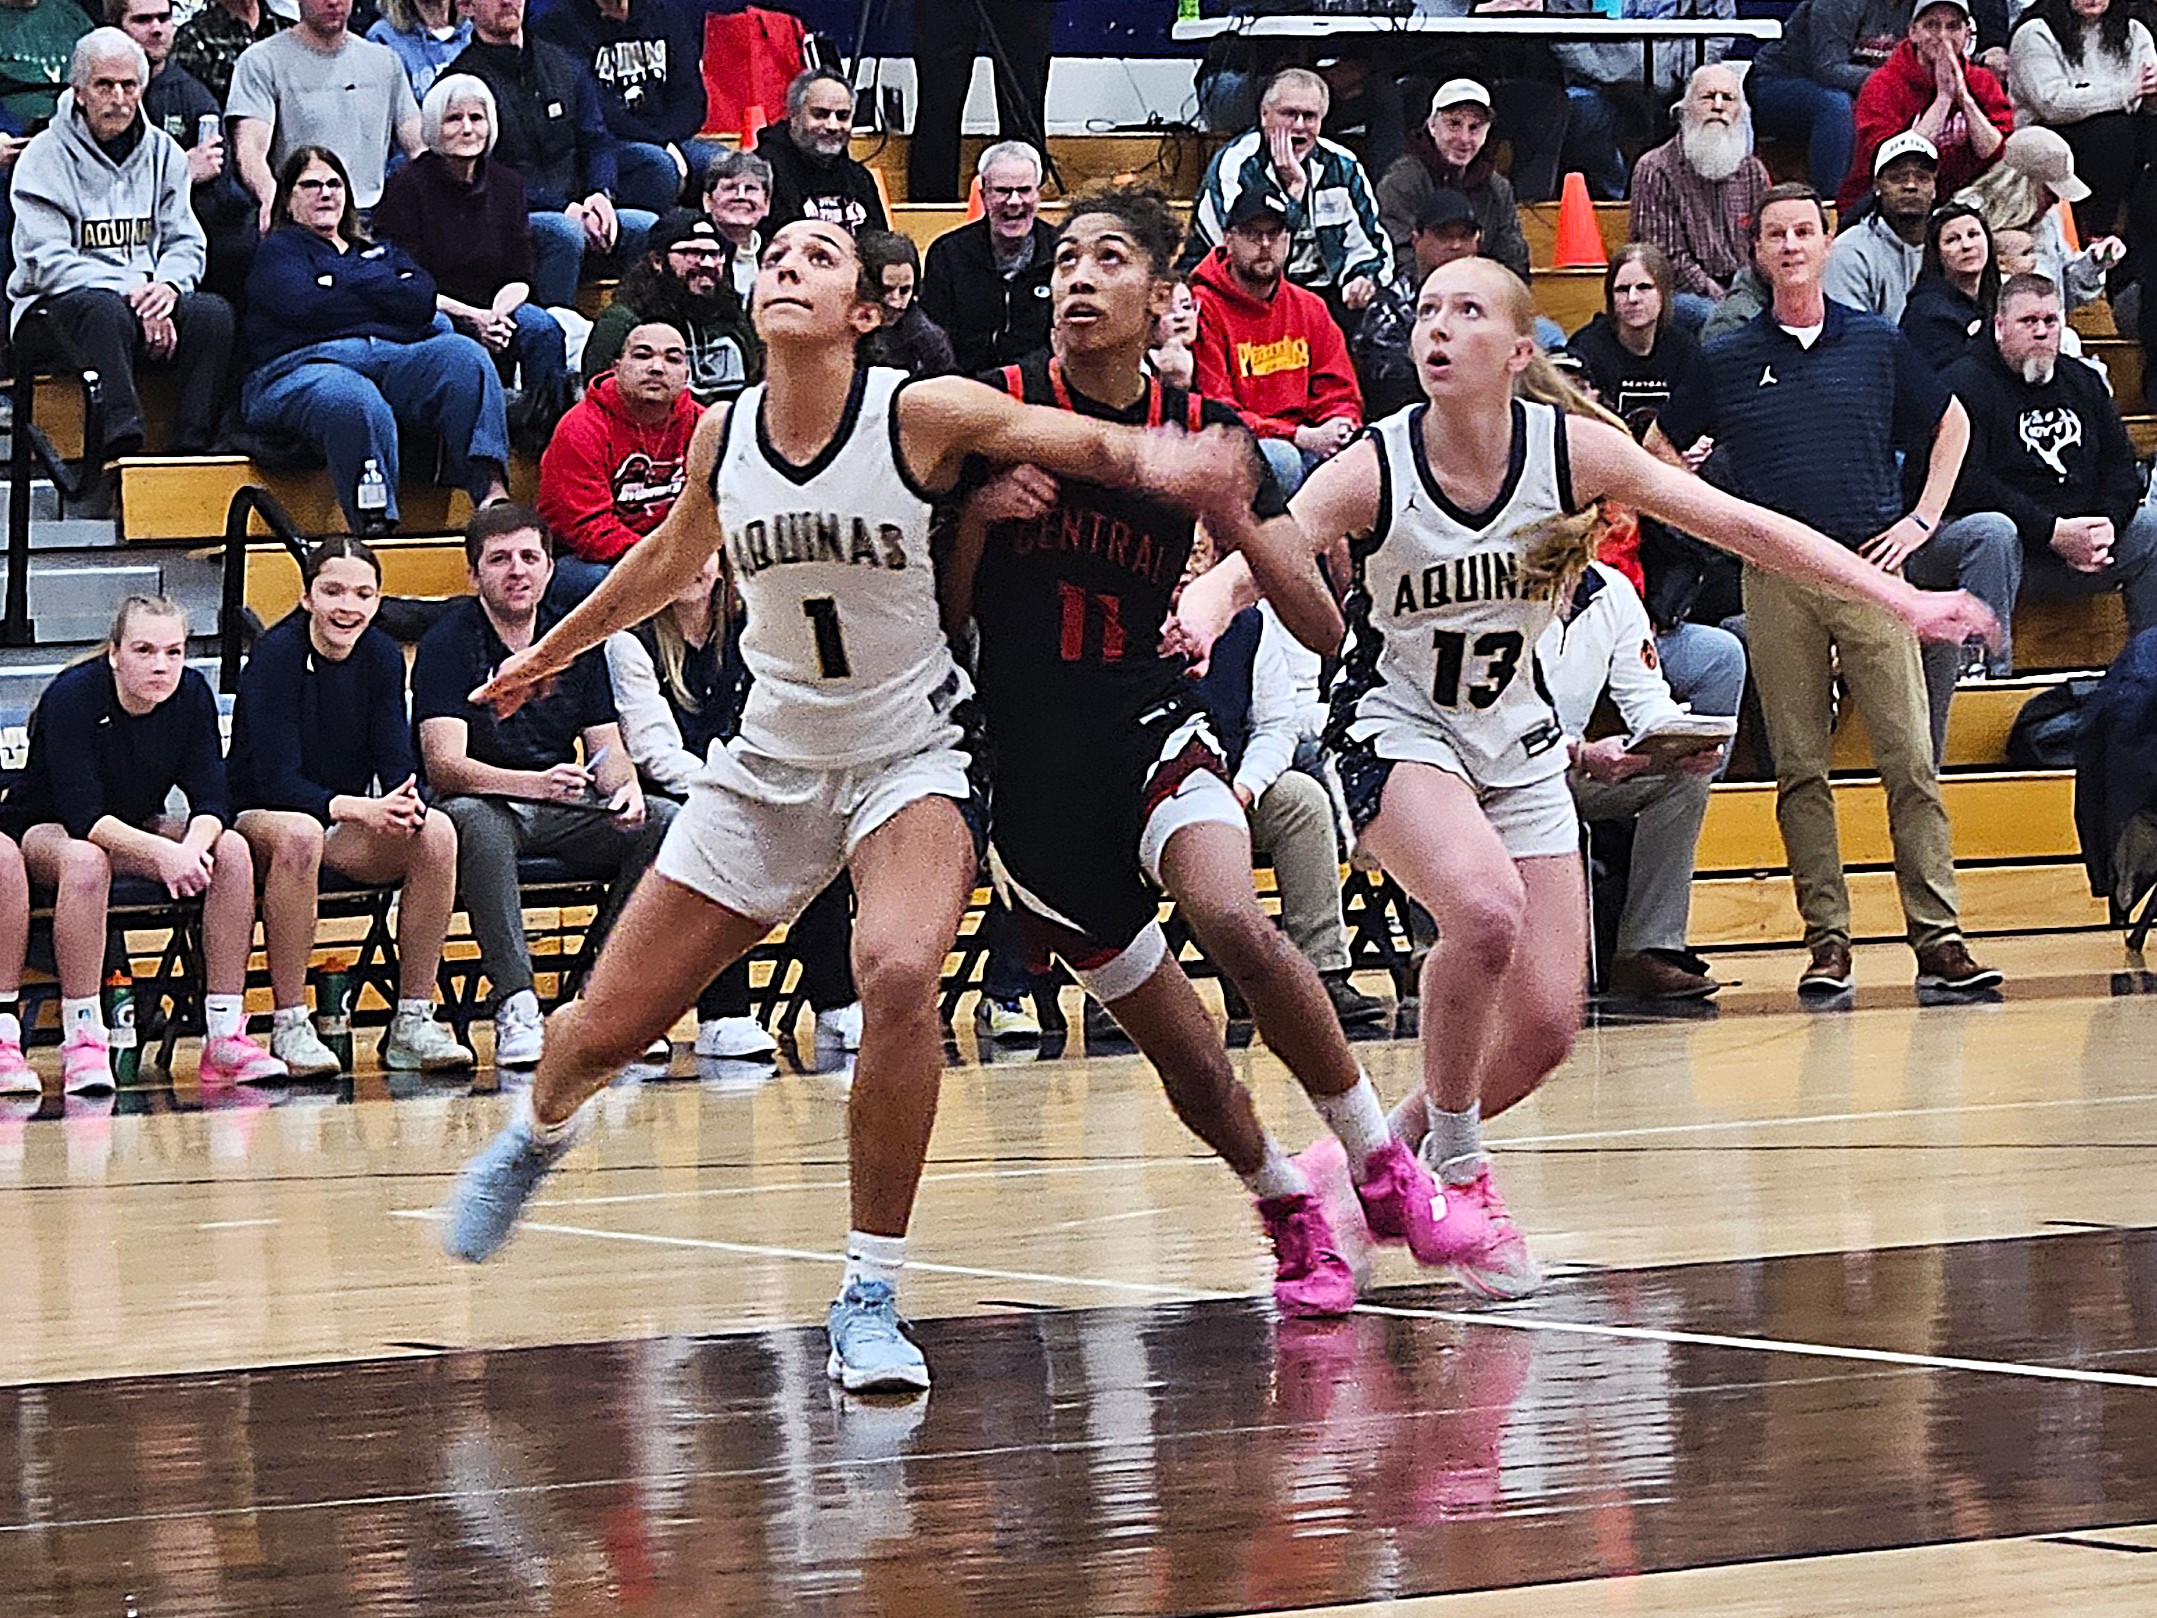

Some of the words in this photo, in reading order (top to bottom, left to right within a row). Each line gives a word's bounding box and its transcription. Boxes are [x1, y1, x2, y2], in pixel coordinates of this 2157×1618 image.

[84, 220, 155, 246] AQUIN
[1058, 579, 1128, 664] 11
[1393, 551, 1549, 618] AQUIN
[802, 595, 852, 679] 1
[1431, 627, 1525, 710] 13
